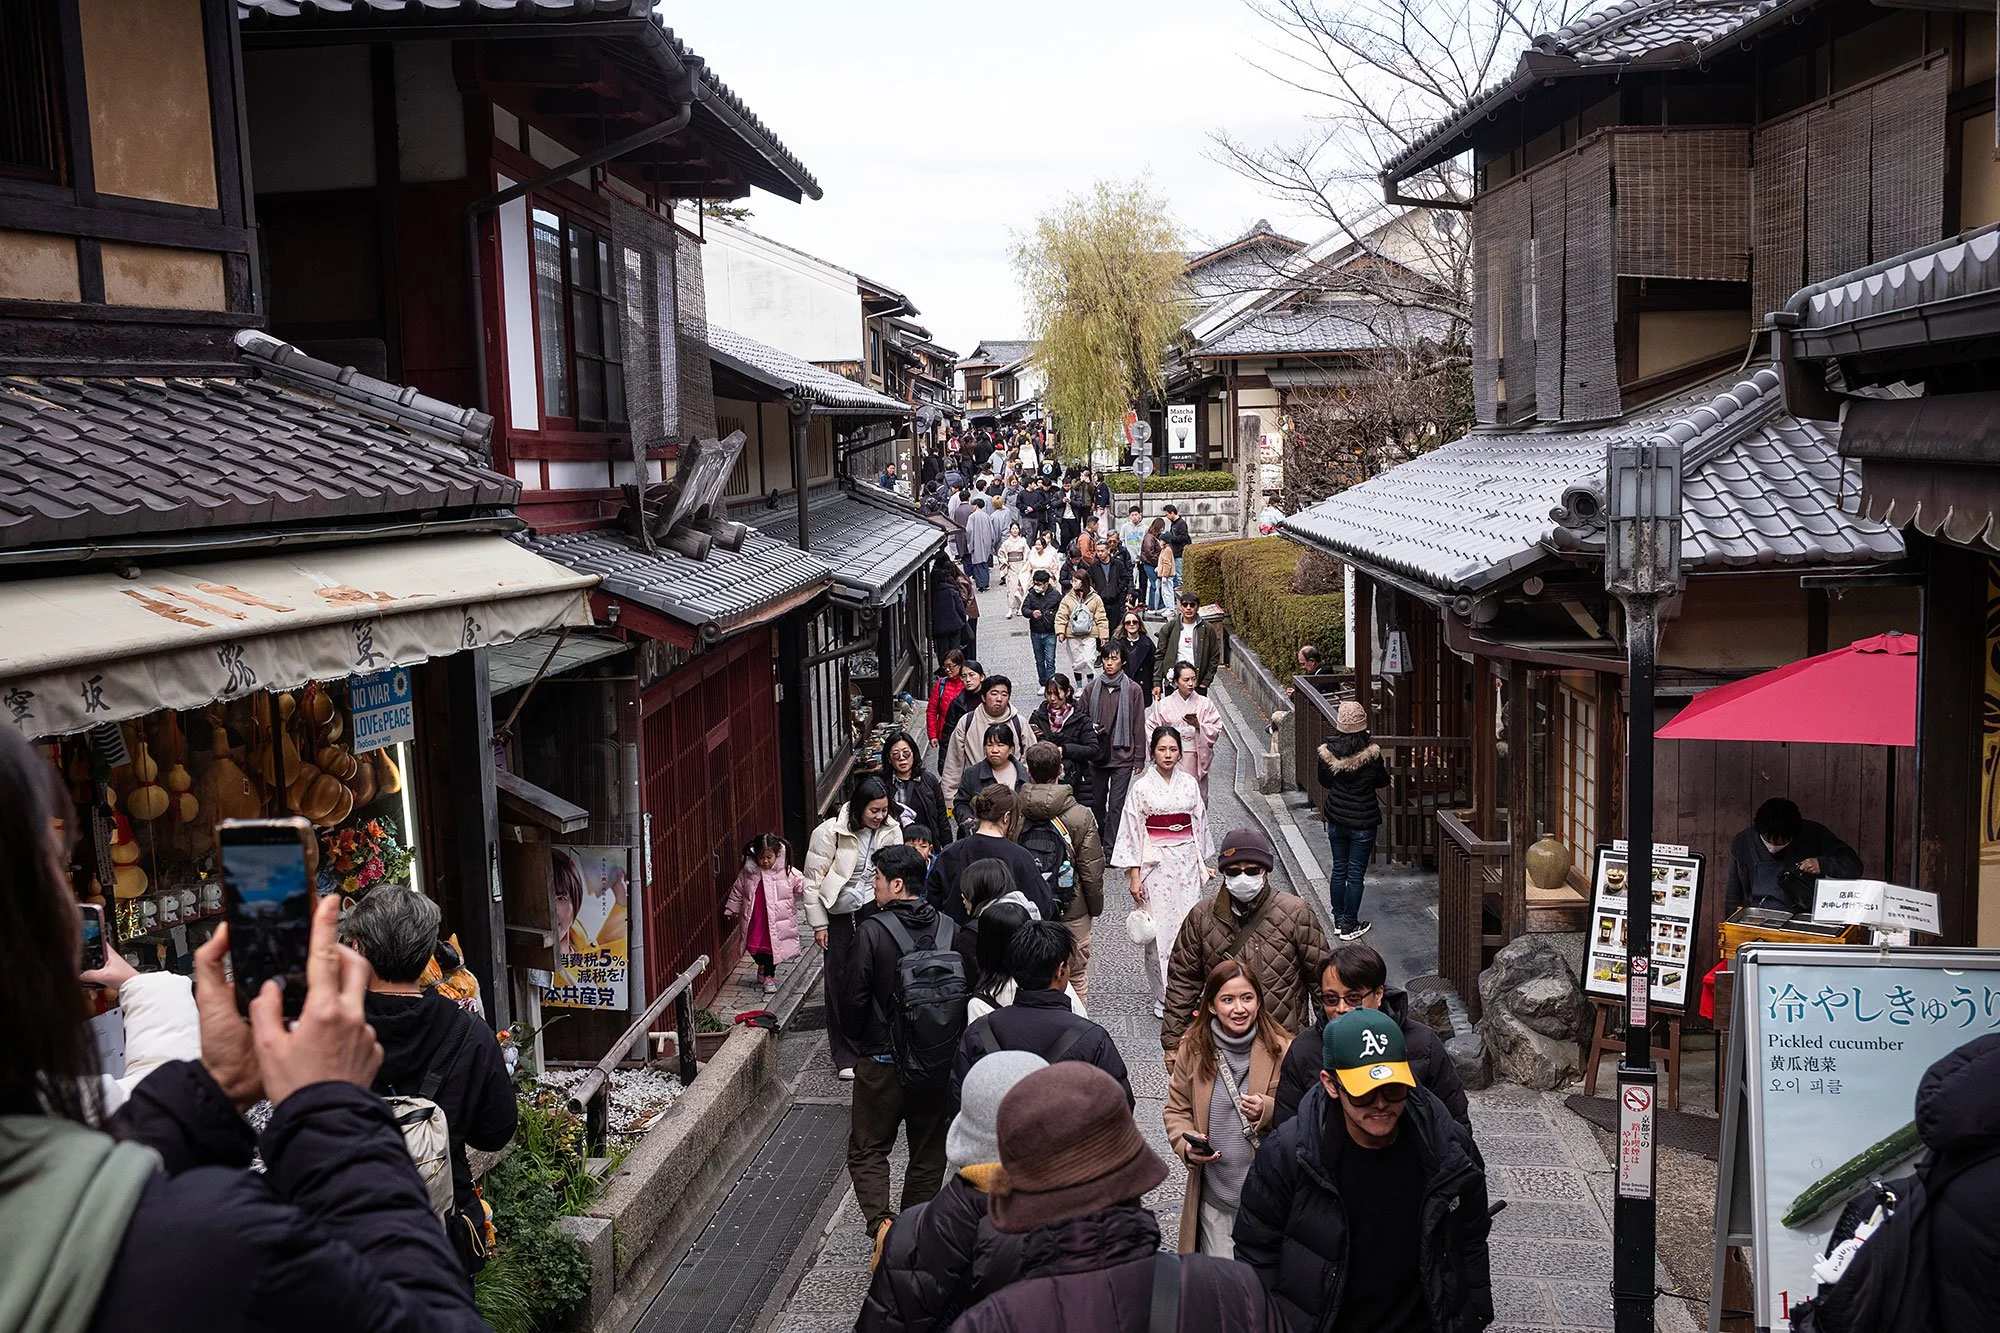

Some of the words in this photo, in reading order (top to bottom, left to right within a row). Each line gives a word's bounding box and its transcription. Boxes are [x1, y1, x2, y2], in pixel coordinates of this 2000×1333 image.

[352, 687, 367, 710] NO
[367, 682, 391, 706] WAR
[354, 706, 411, 739] LOVE&PEACE
[540, 985, 615, 1007] 本共産党
[1359, 1028, 1389, 1059] A's
[1767, 1033, 1823, 1050] Pickled
[1828, 1036, 1904, 1051] cucumber
[1220, 1062, 1238, 1094] LOEWE
[1769, 1055, 1837, 1072] 黄瓜泡菜
[1769, 1077, 1800, 1094] 오이
[1809, 1078, 1844, 1095] 피클
[1631, 1122, 1640, 1164] 路上喫煙は
[1640, 1114, 1651, 1148] 京都での
[1622, 1130, 1631, 1180] やめましょう
